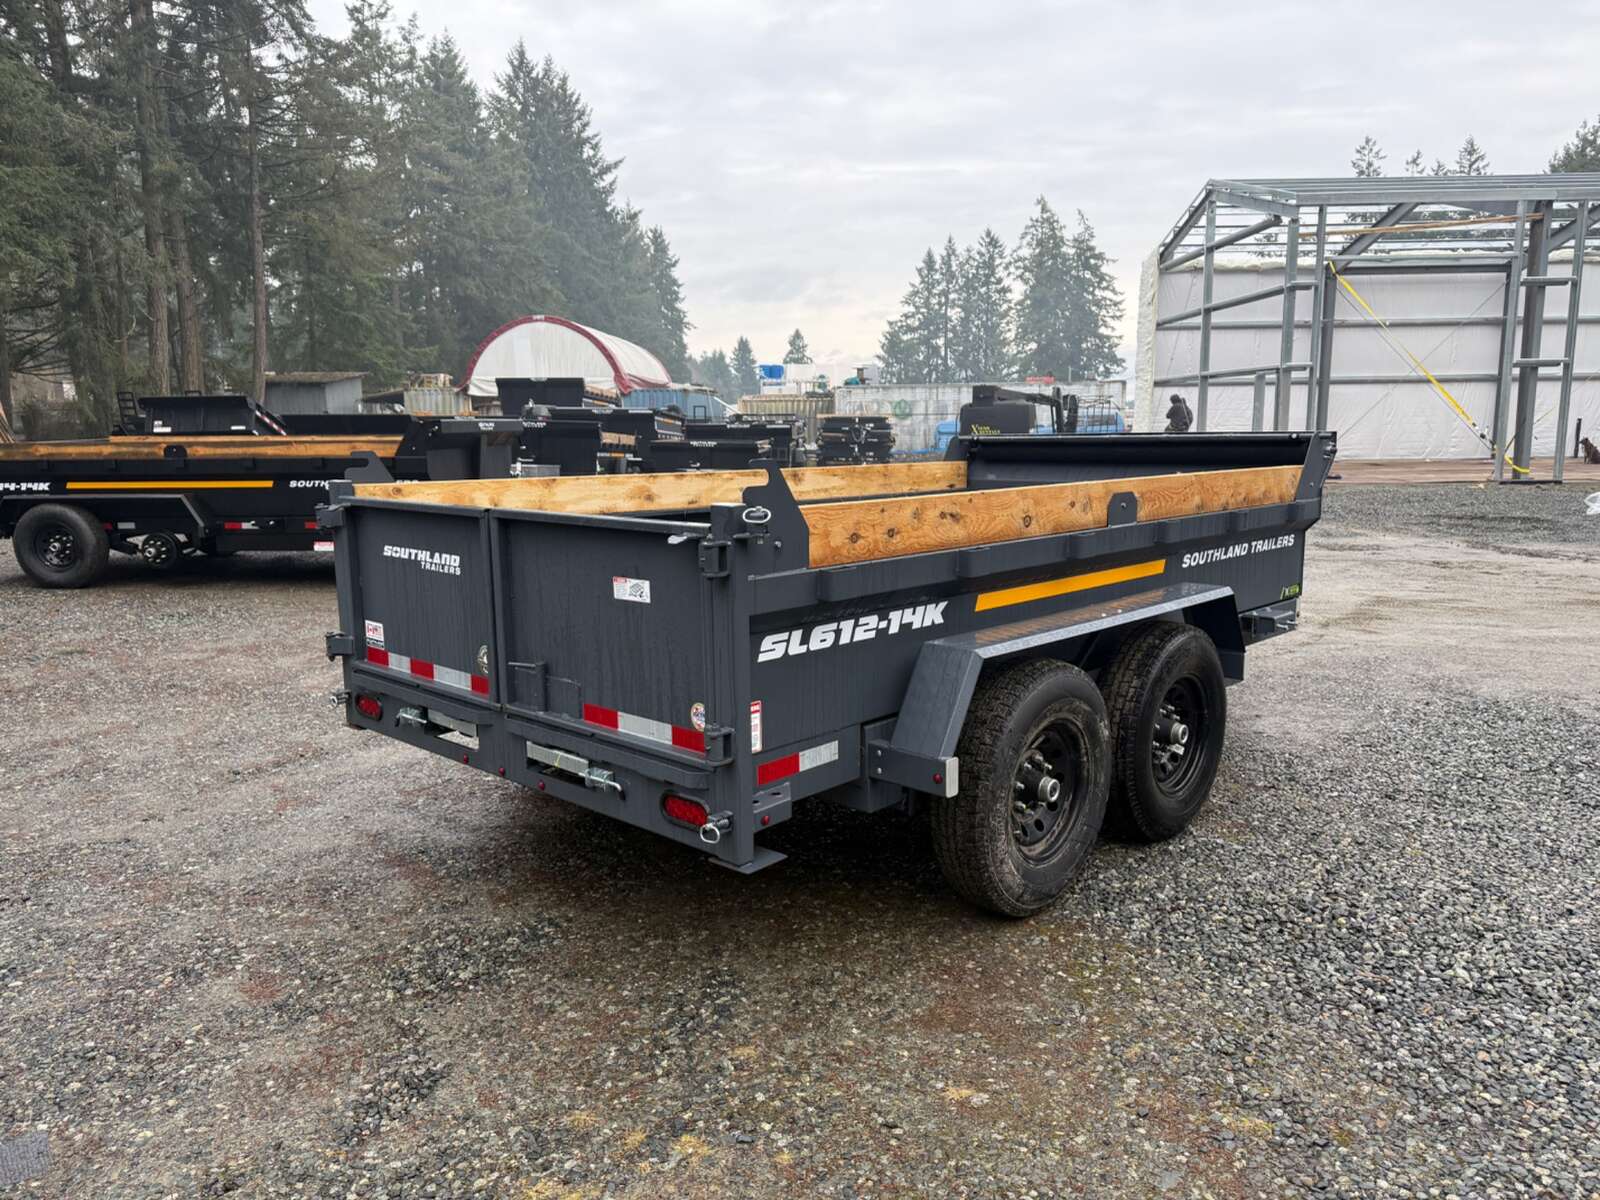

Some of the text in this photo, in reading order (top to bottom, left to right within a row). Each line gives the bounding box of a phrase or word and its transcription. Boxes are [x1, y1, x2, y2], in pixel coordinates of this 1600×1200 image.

[289, 480, 329, 489] SOUTH
[383, 545, 460, 567] SOUTHLAND
[1181, 534, 1295, 568] SOUTHLAND TRAILERS
[421, 561, 461, 576] TRAILERS
[757, 601, 949, 663] SL612-14K
